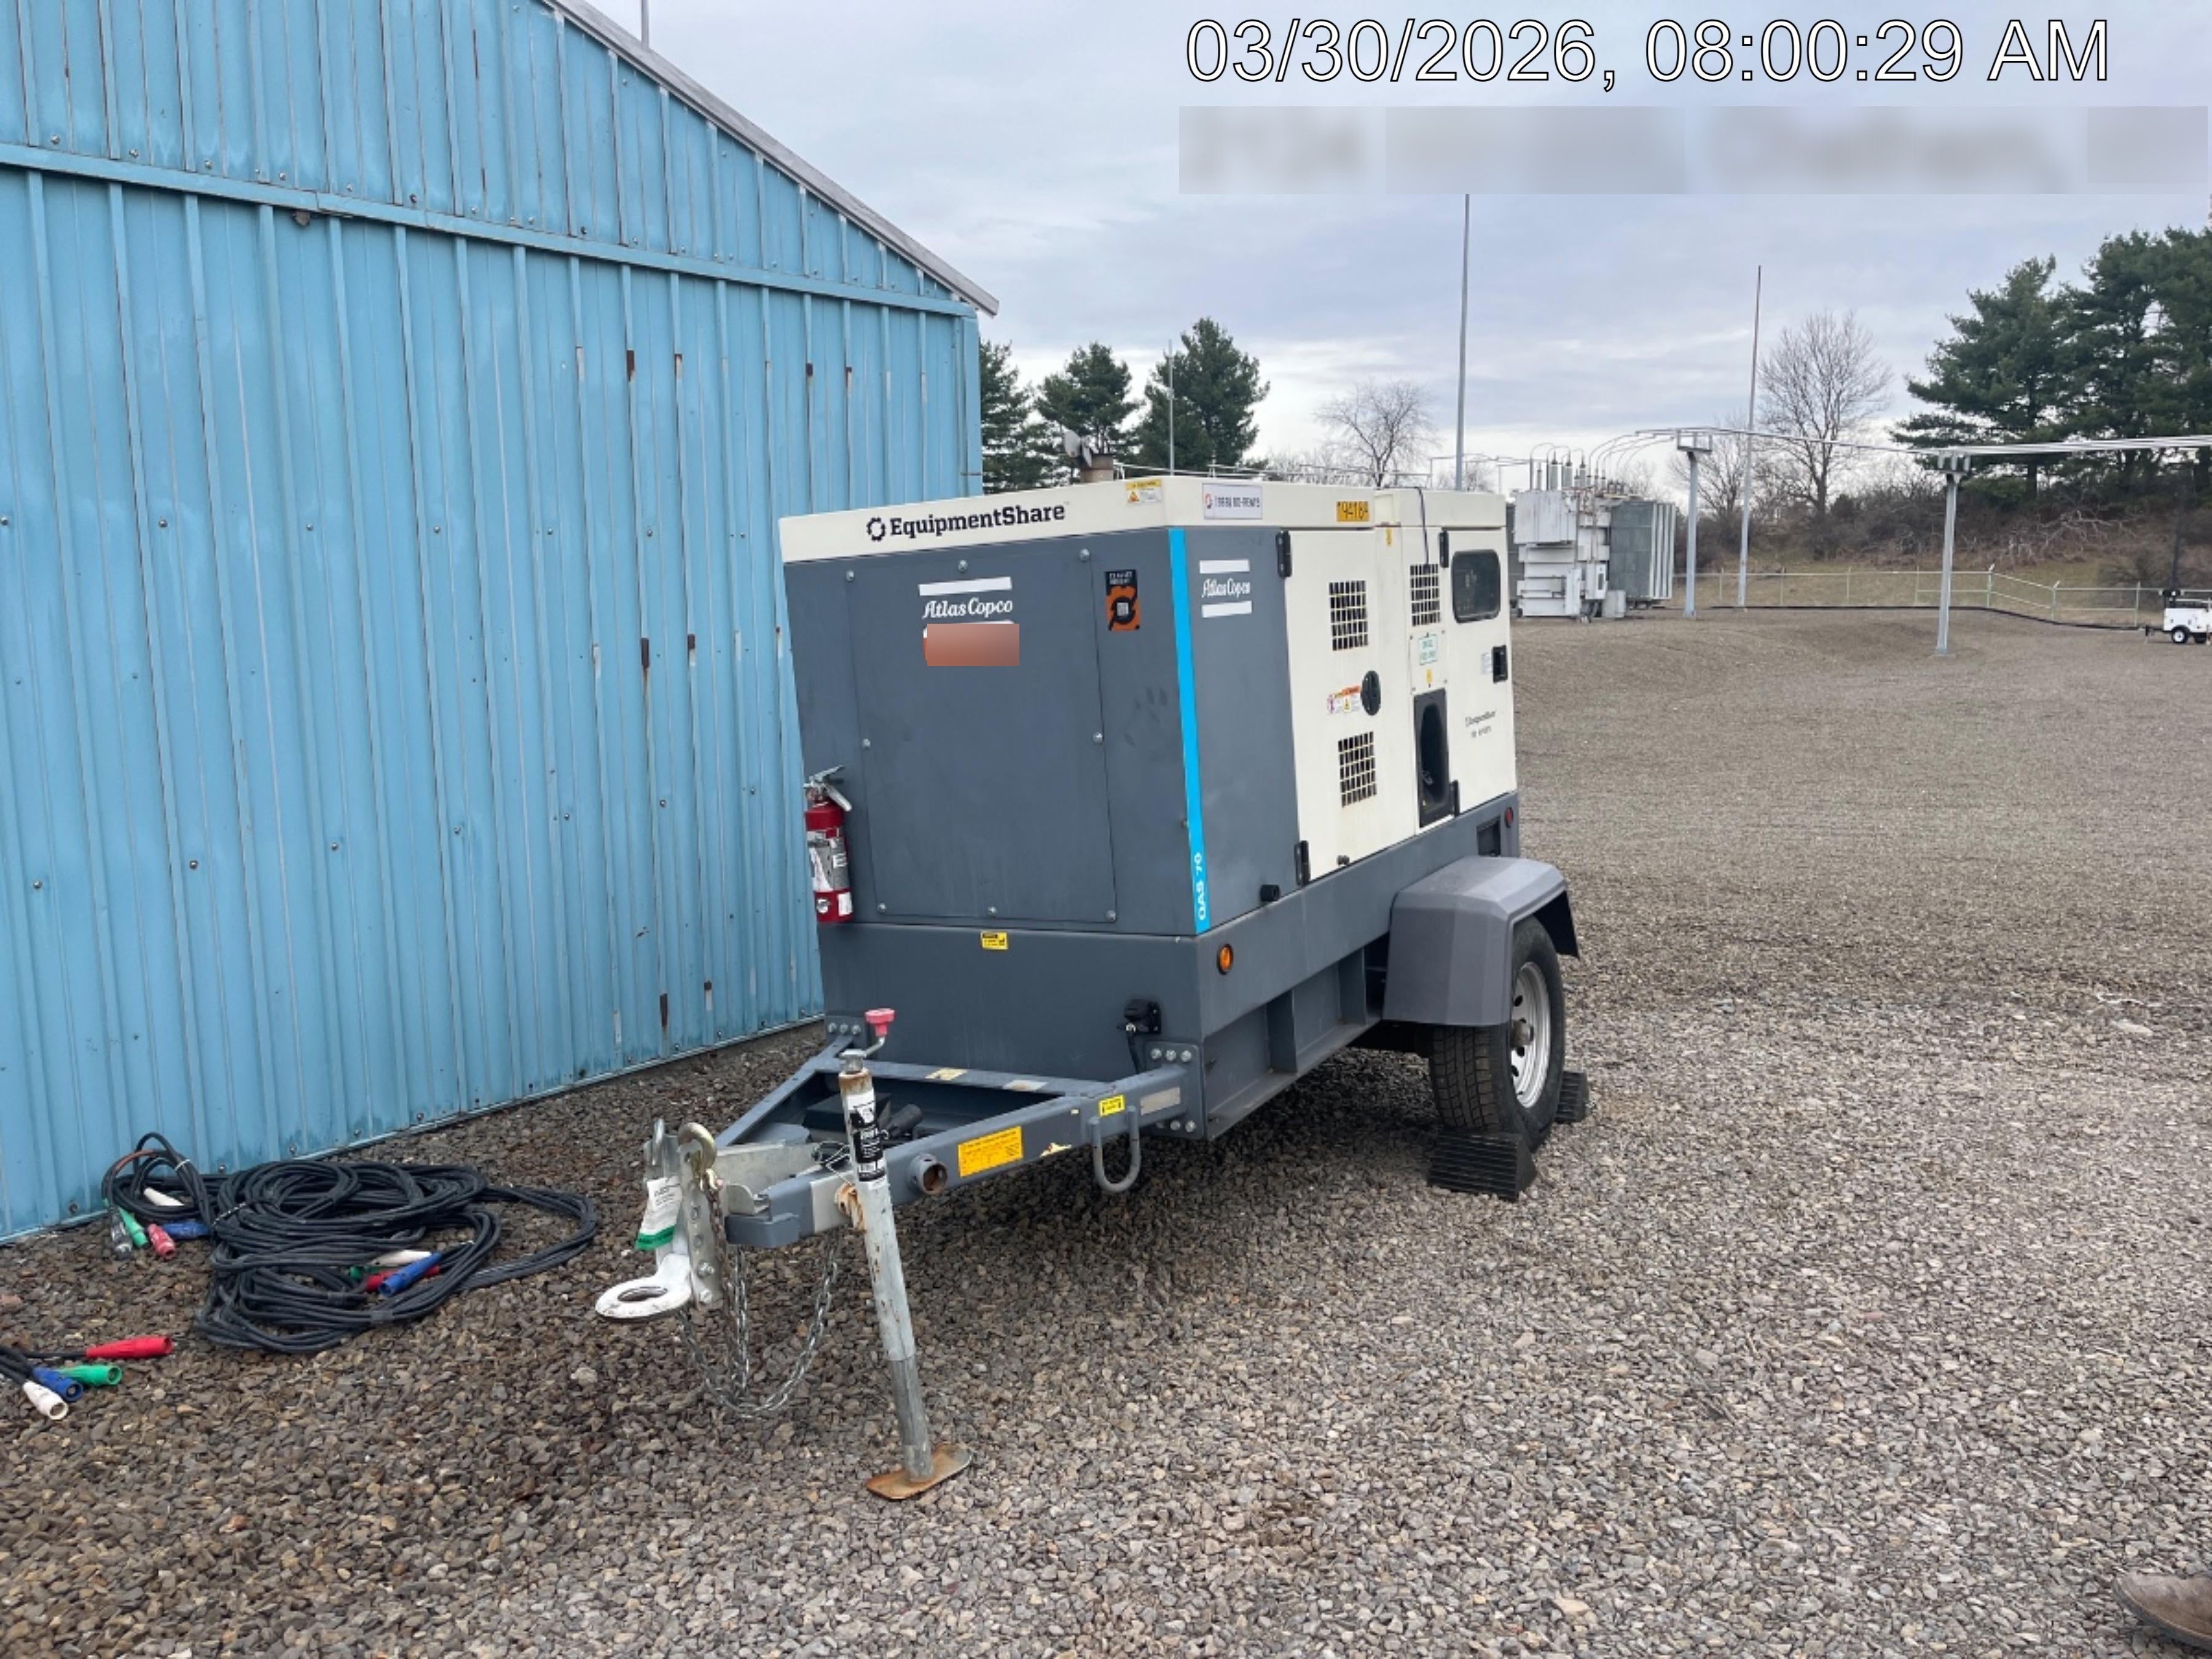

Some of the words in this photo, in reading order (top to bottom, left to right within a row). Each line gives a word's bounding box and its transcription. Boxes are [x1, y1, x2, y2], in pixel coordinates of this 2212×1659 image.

[890, 504, 1065, 539] EquipmentShare
[922, 598, 967, 619] Atlas
[967, 597, 1013, 618] Copco
